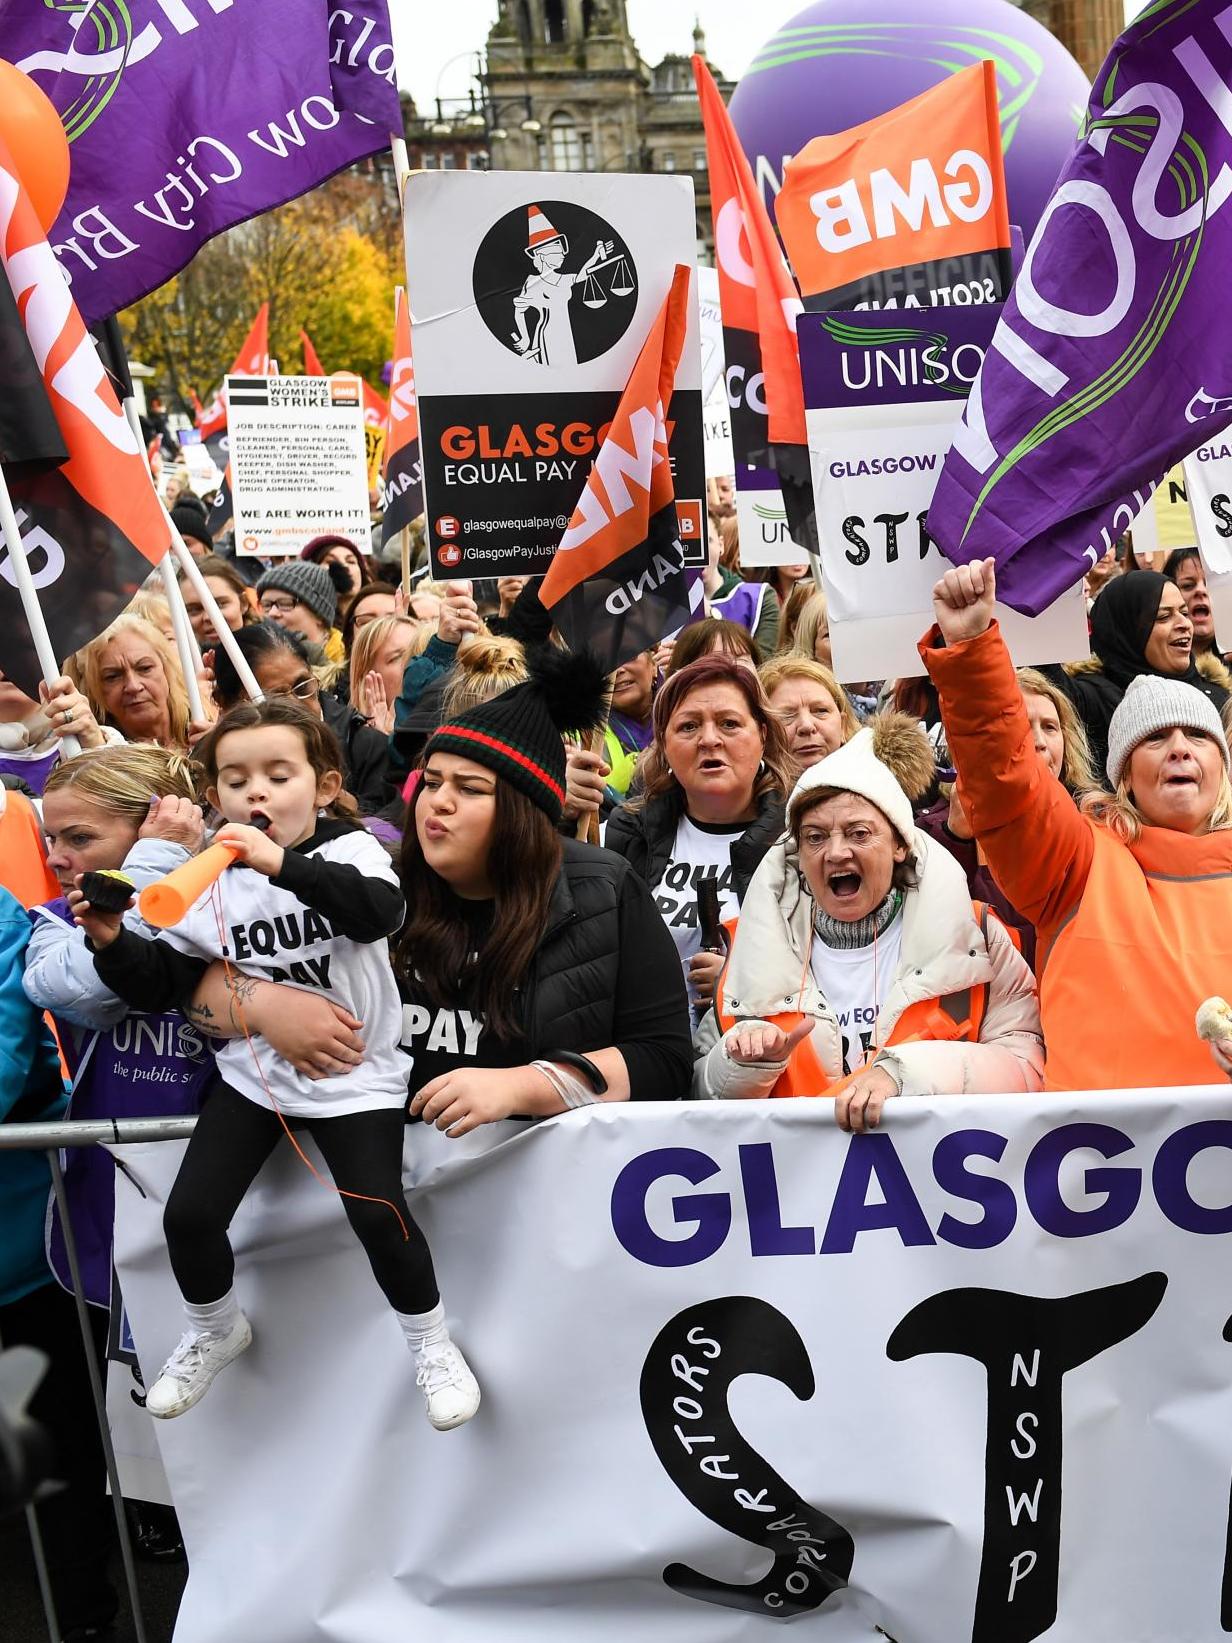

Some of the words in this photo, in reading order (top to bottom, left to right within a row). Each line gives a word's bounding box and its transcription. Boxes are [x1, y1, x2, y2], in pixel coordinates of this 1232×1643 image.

[269, 379, 328, 387] GLASGOW
[270, 388, 329, 396] WOMEN'S
[271, 397, 330, 407] STRIKE
[445, 461, 528, 486] EQUAL
[535, 459, 577, 481] PAY
[829, 453, 937, 479] GLASGOW
[241, 510, 261, 518] WE
[265, 510, 291, 518] ARE
[296, 510, 343, 518] WORTH
[348, 510, 364, 518] IT!
[400, 1003, 486, 1056] PAY
[113, 1061, 128, 1078] the
[132, 1067, 178, 1083] public
[1006, 1349, 1043, 1602] NSWP
